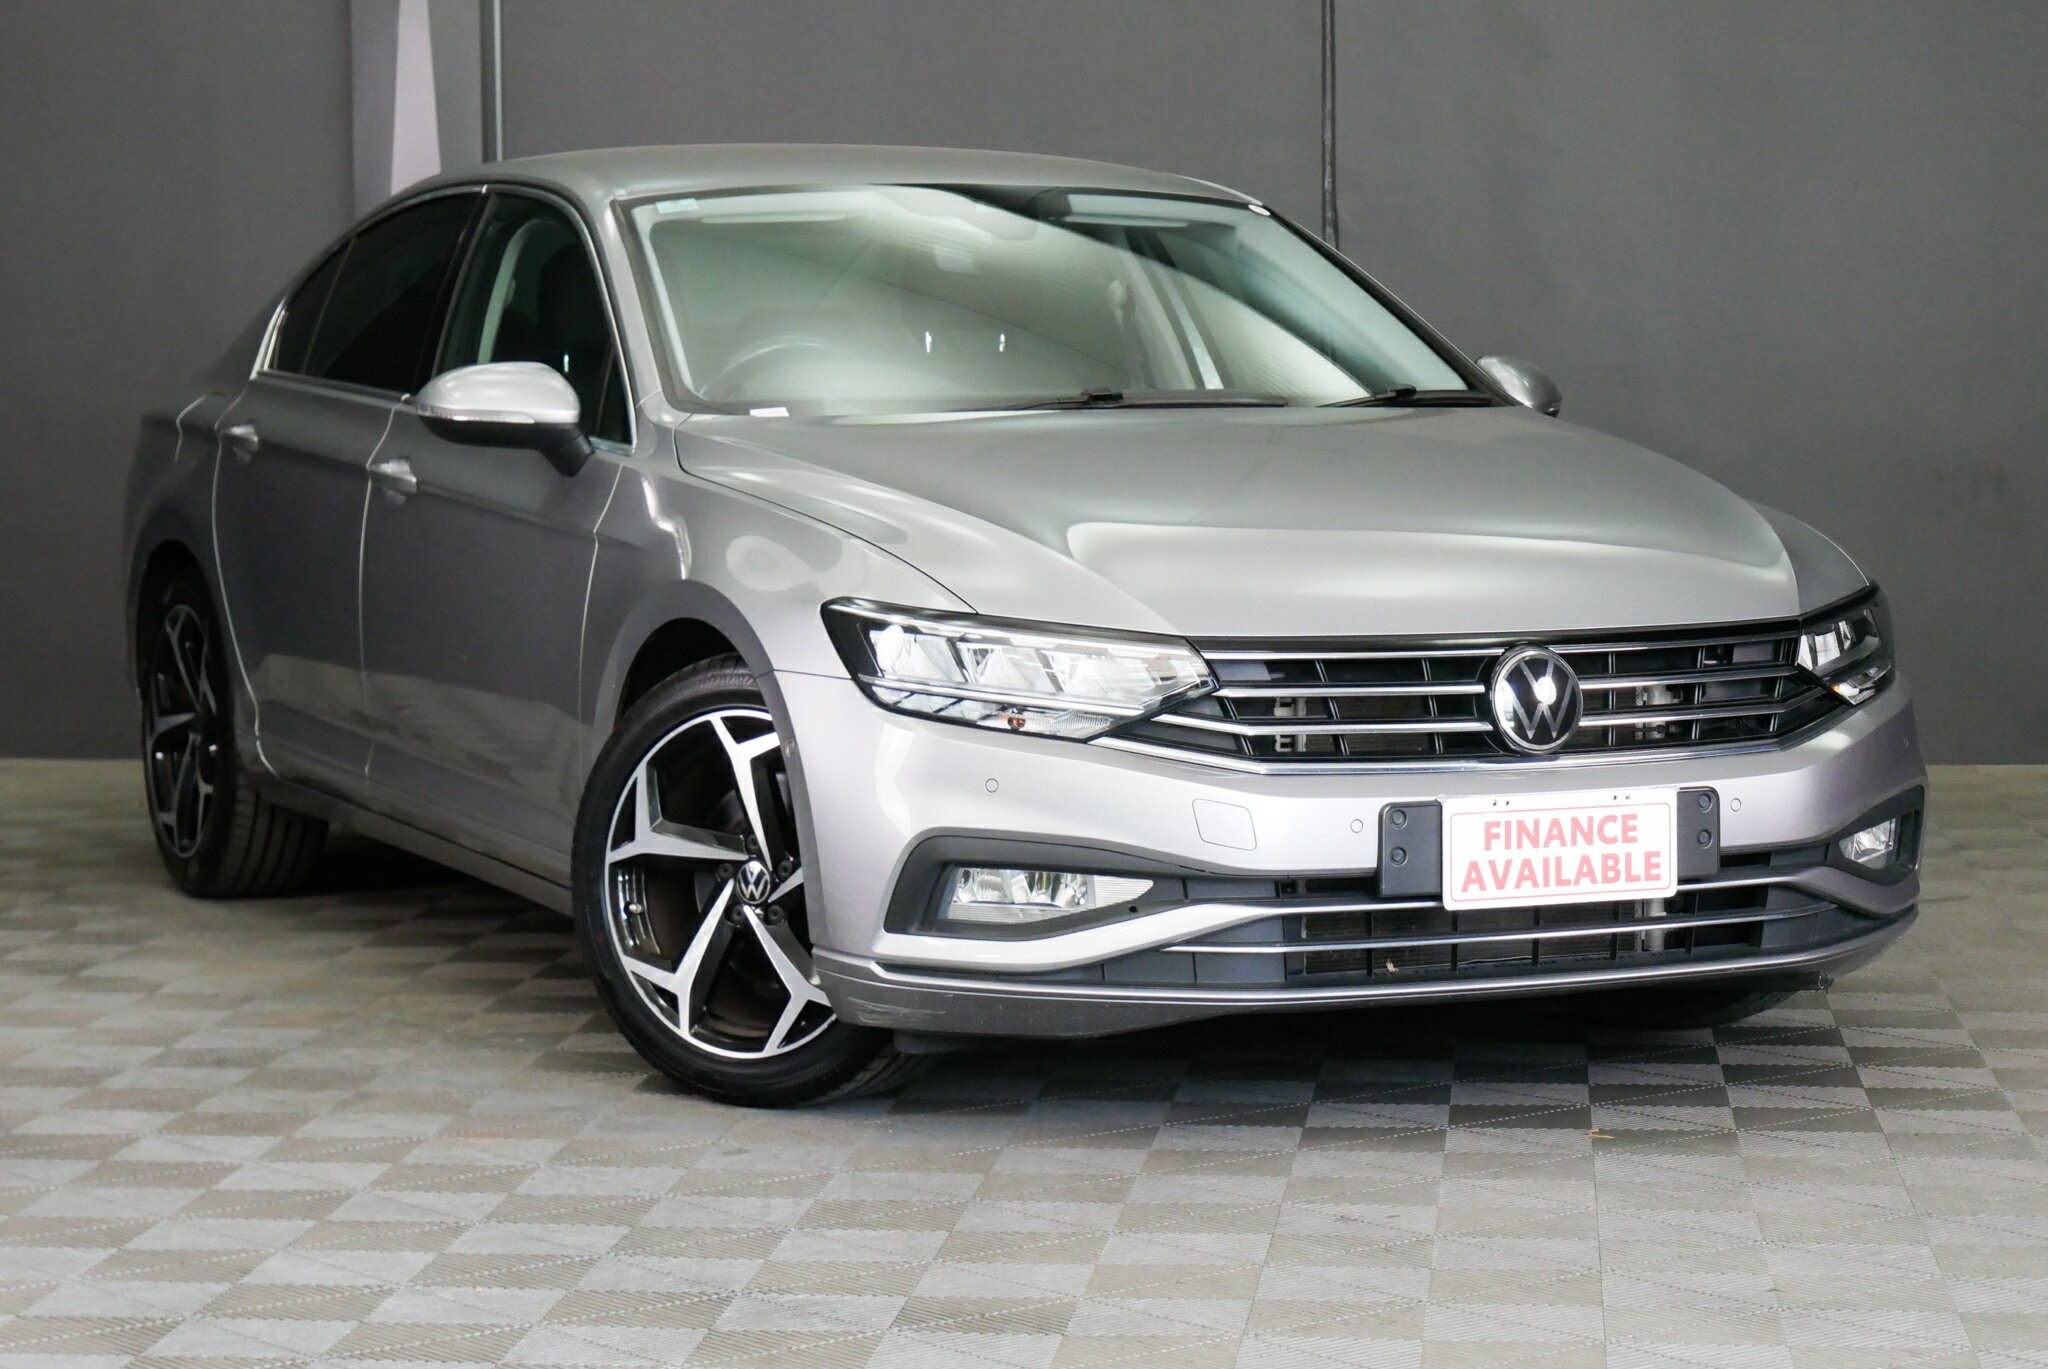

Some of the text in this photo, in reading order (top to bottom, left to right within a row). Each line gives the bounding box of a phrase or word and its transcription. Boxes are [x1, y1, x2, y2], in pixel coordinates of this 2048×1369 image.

[1495, 652, 1579, 747] VW
[1484, 814, 1638, 851] FINANCE
[738, 861, 770, 903] VW
[1461, 851, 1662, 893] AVAILABLE
